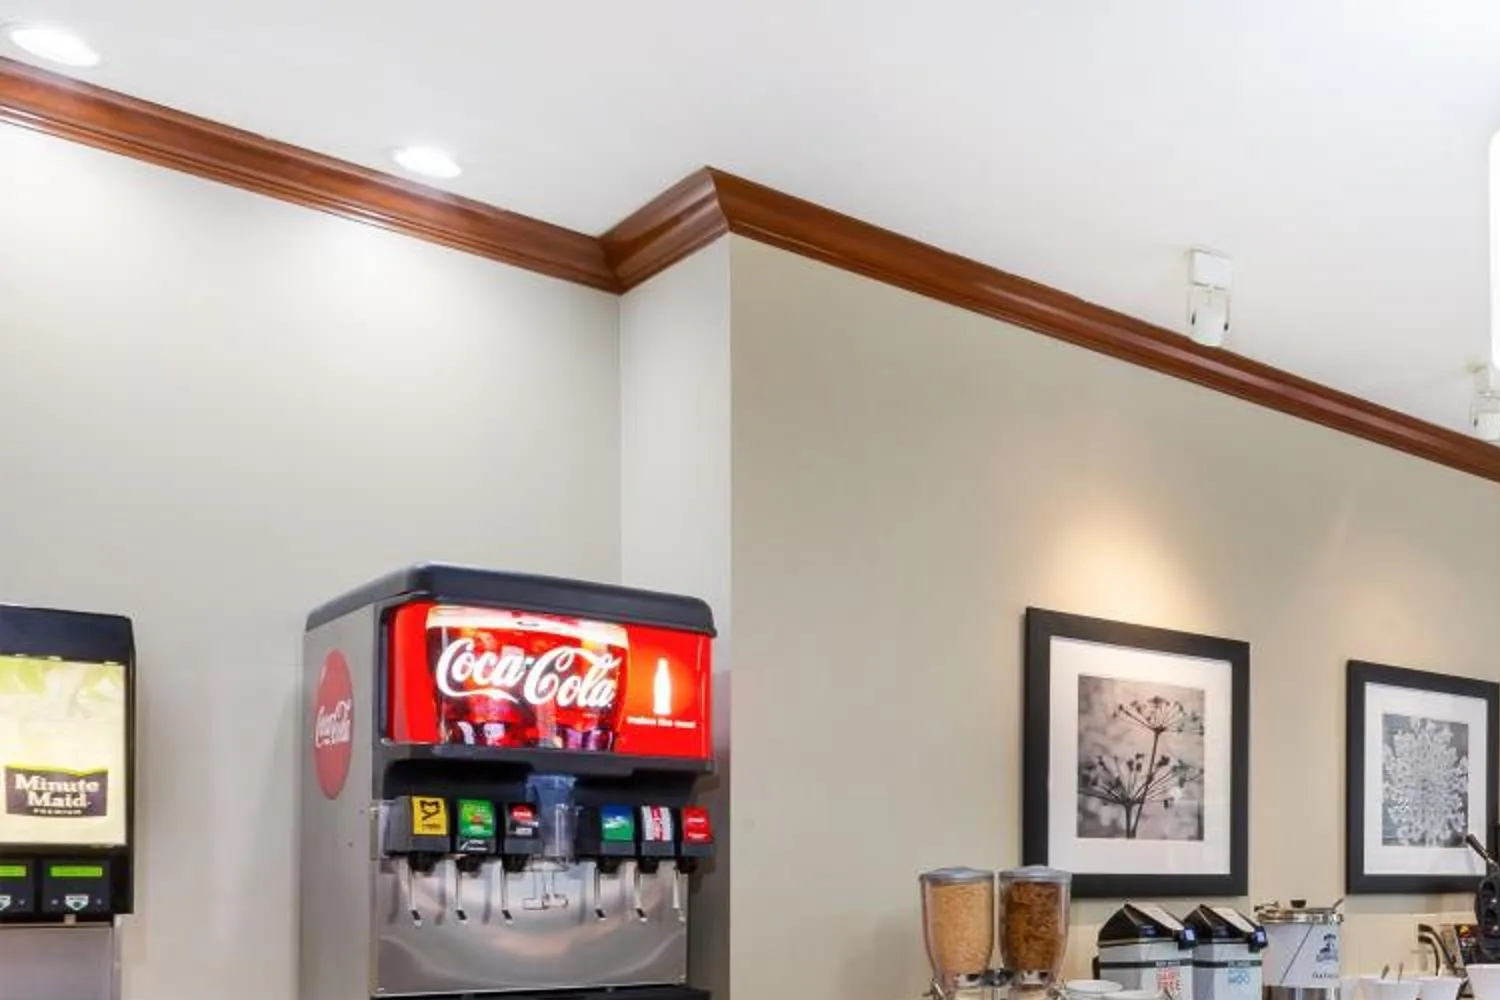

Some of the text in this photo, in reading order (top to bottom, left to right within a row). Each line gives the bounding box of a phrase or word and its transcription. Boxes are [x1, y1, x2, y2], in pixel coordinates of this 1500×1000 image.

[435, 637, 622, 708] Coca-Cola
[14, 773, 99, 793] Minute
[28, 790, 87, 807] Maid
